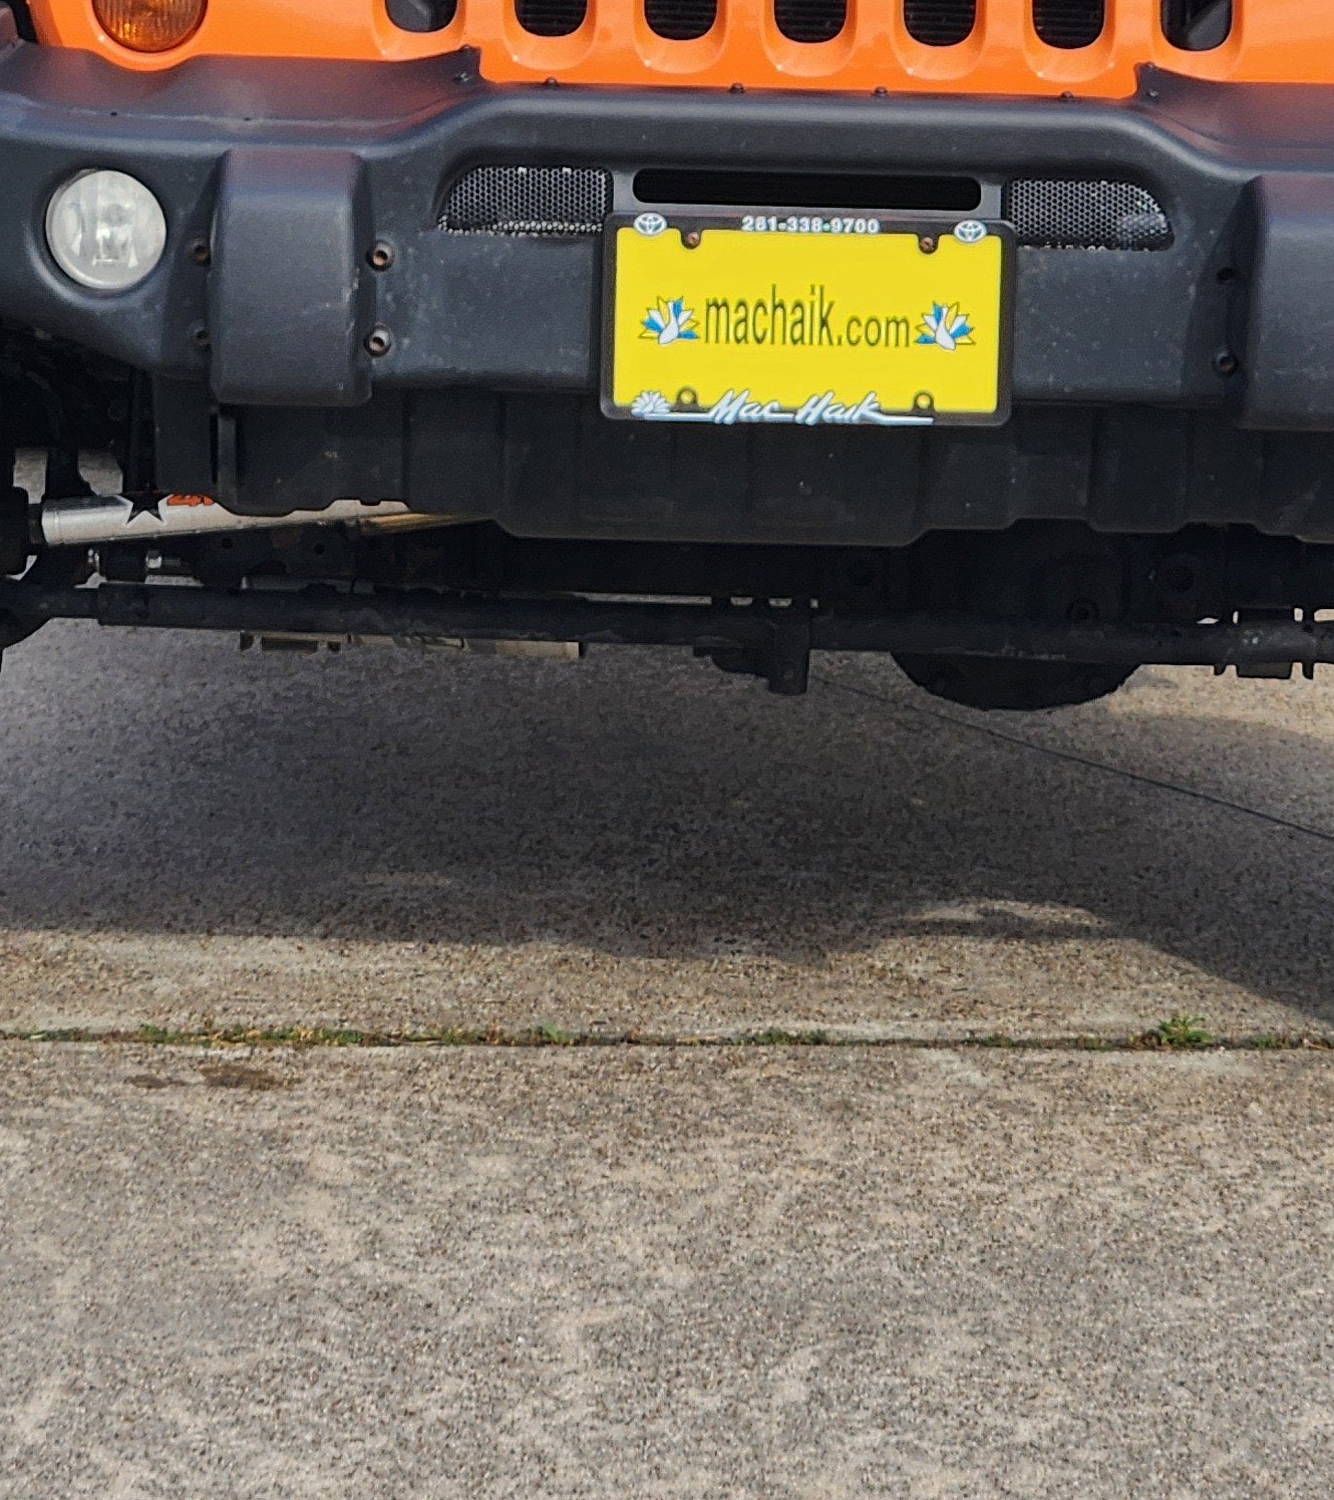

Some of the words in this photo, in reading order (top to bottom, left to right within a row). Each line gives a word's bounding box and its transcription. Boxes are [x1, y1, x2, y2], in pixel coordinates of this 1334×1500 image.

[704, 283, 910, 348] machaik.com
[708, 388, 794, 426] Mac
[795, 389, 883, 427] Haik
